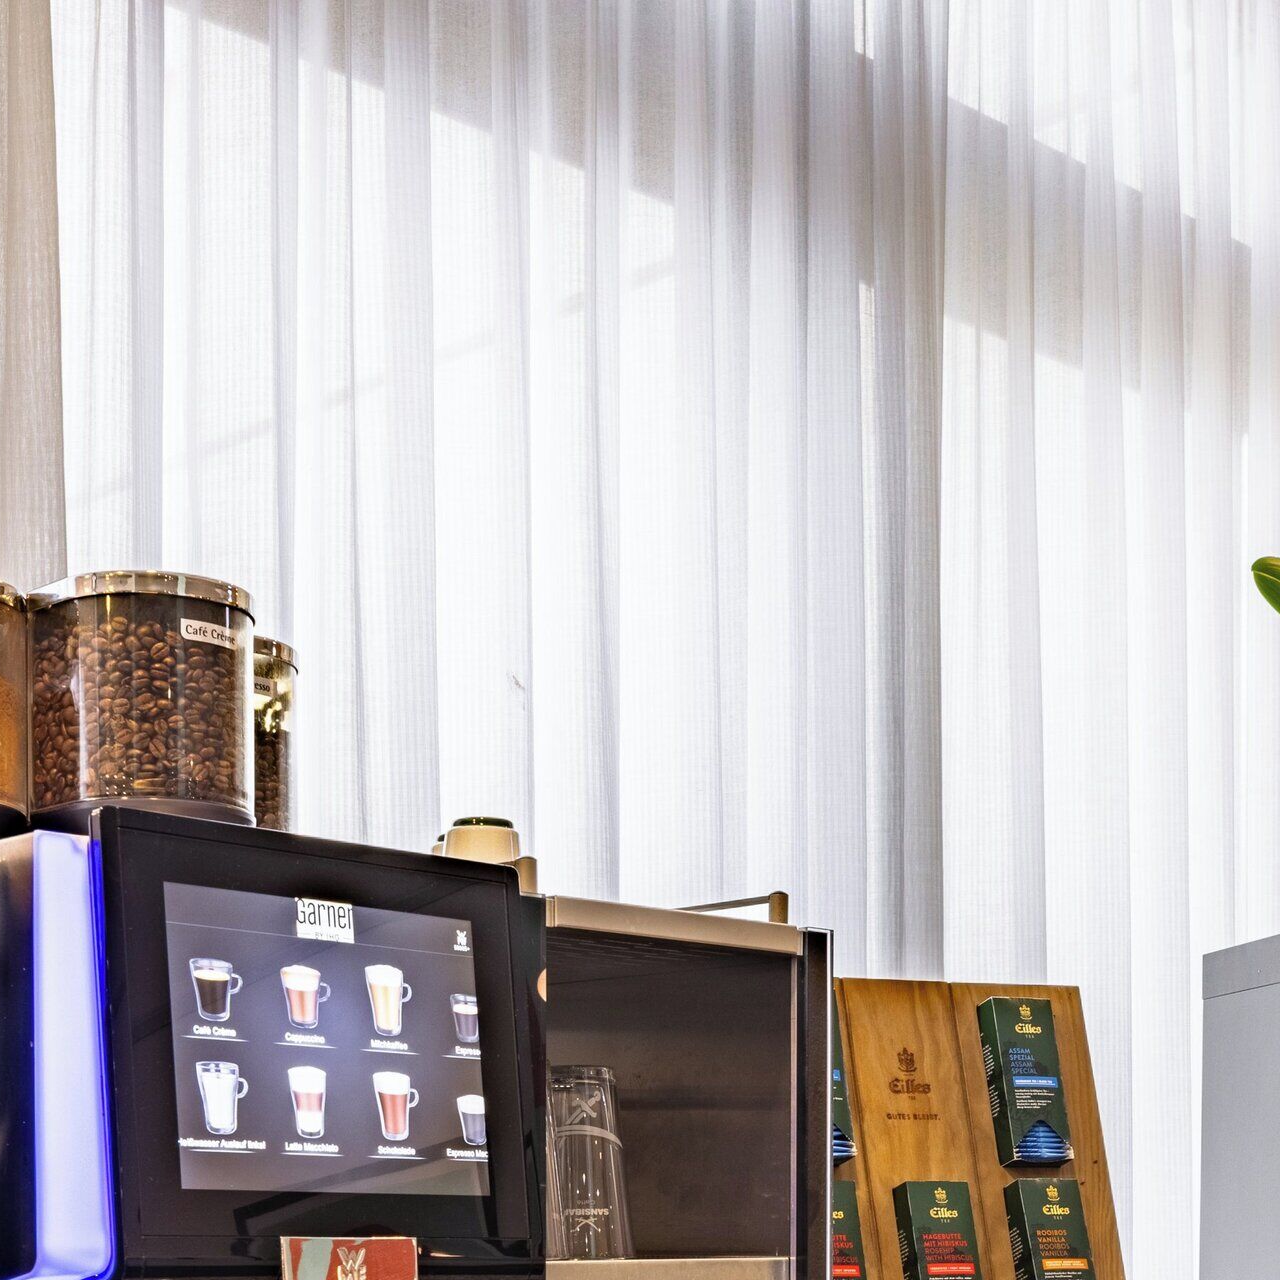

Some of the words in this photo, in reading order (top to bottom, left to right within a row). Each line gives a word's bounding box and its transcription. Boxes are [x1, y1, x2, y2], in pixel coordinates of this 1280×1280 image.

[185, 624, 208, 638] Café
[210, 628, 236, 645] Crème
[254, 681, 271, 693] esso
[296, 898, 353, 930] Garner
[1014, 1023, 1042, 1034] Eilles
[888, 1078, 931, 1095] Eilles
[929, 1207, 958, 1219] Eilles
[1042, 1204, 1070, 1216] Eilles
